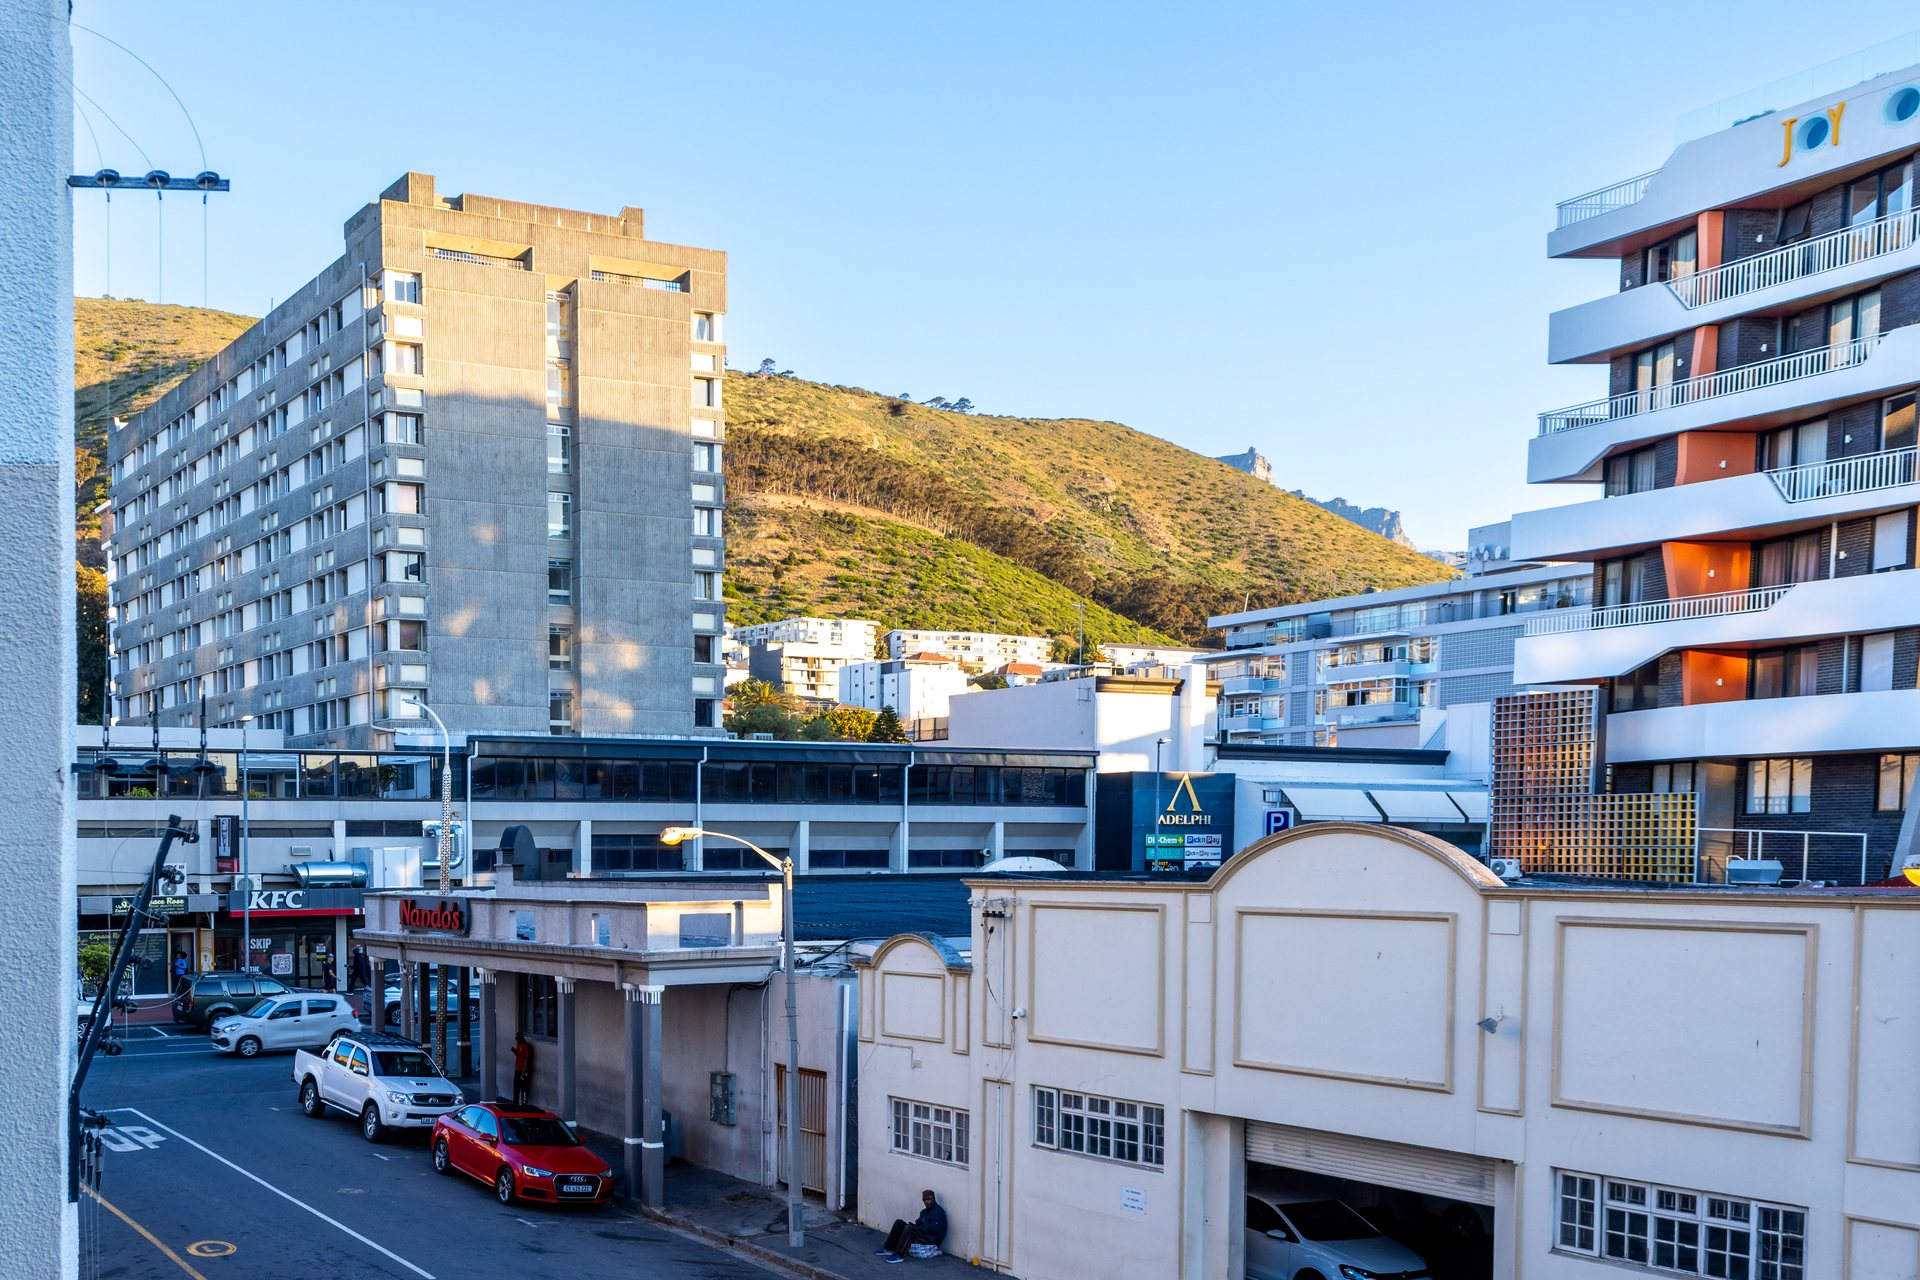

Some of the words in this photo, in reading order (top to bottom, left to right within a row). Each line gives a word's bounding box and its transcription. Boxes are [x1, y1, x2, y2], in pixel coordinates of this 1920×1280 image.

[1158, 815, 1212, 825] ADELPHI
[1147, 836, 1178, 844] Di-Chem
[166, 897, 185, 905] Rose
[249, 890, 303, 909] KFC
[400, 897, 460, 929] Nando's
[250, 938, 272, 949] SKIP
